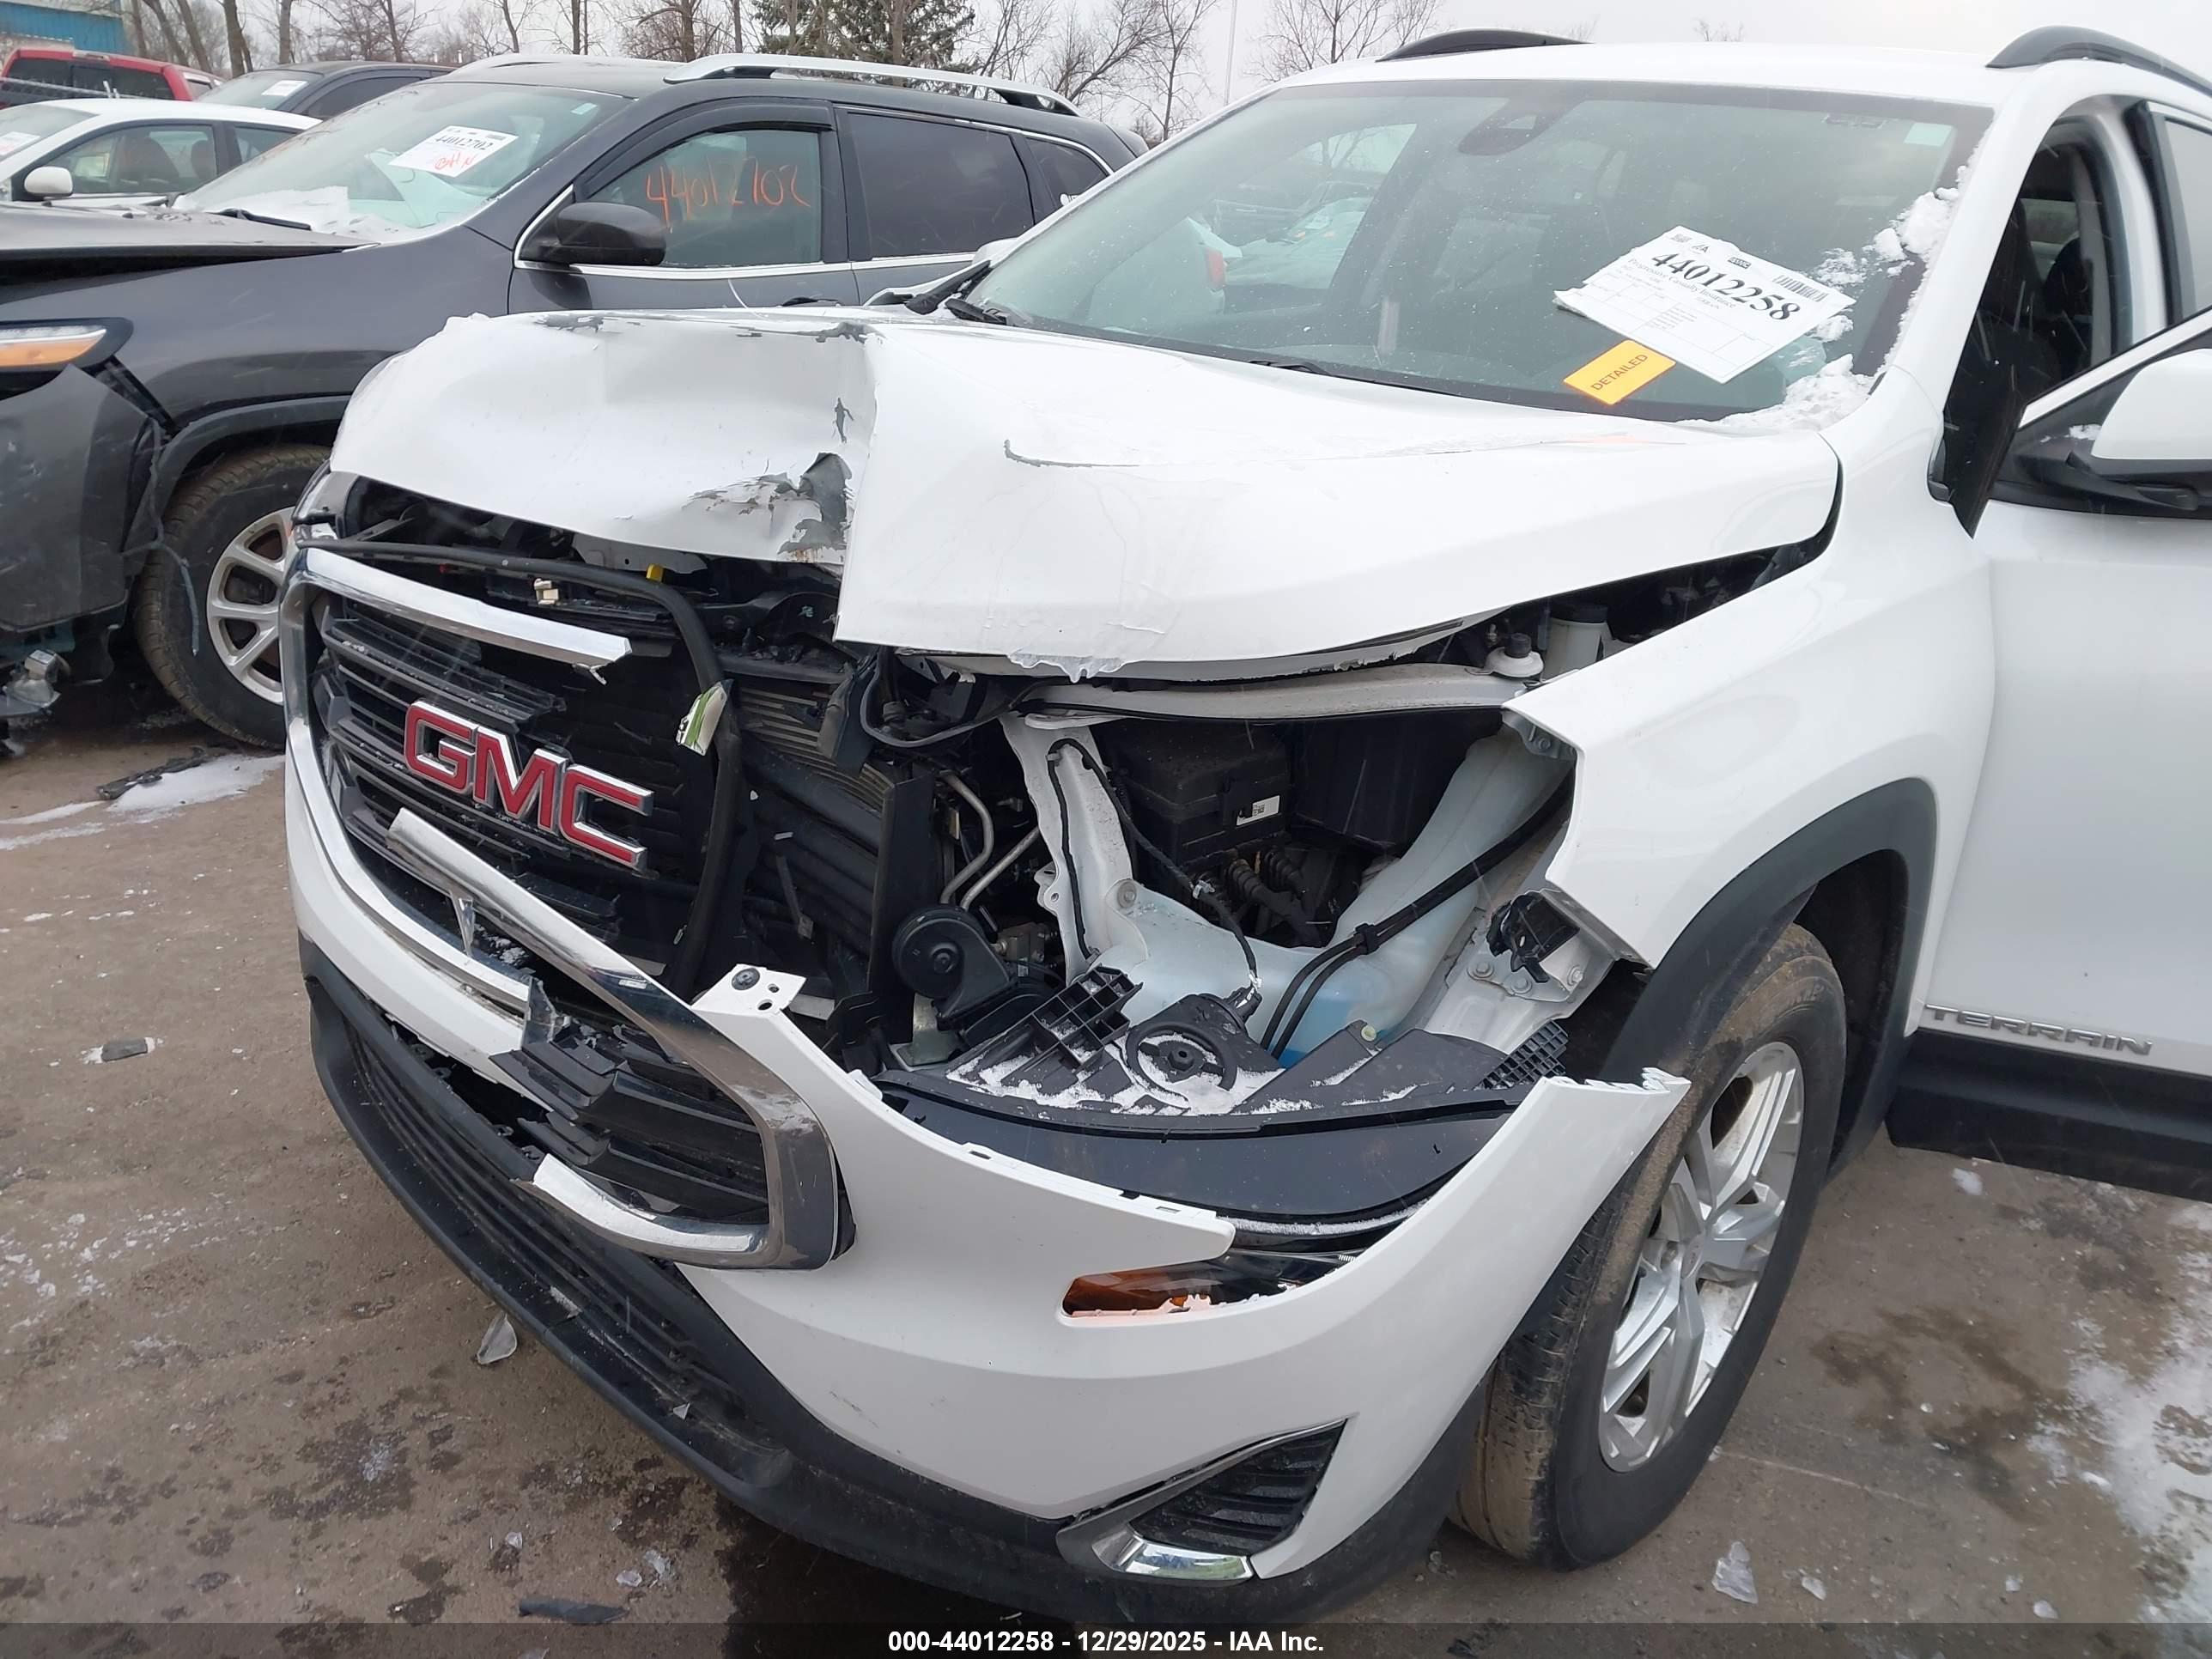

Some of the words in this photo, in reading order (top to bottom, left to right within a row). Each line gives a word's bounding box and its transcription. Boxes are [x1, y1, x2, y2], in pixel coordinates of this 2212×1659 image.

[434, 135, 494, 150] 44012702
[1651, 252, 1801, 320] 44012258
[1698, 289, 1737, 309] Insurance
[1590, 354, 1648, 391] DETAILED
[404, 699, 654, 871] GMC
[1925, 1003, 2153, 1055] TERRAIN
